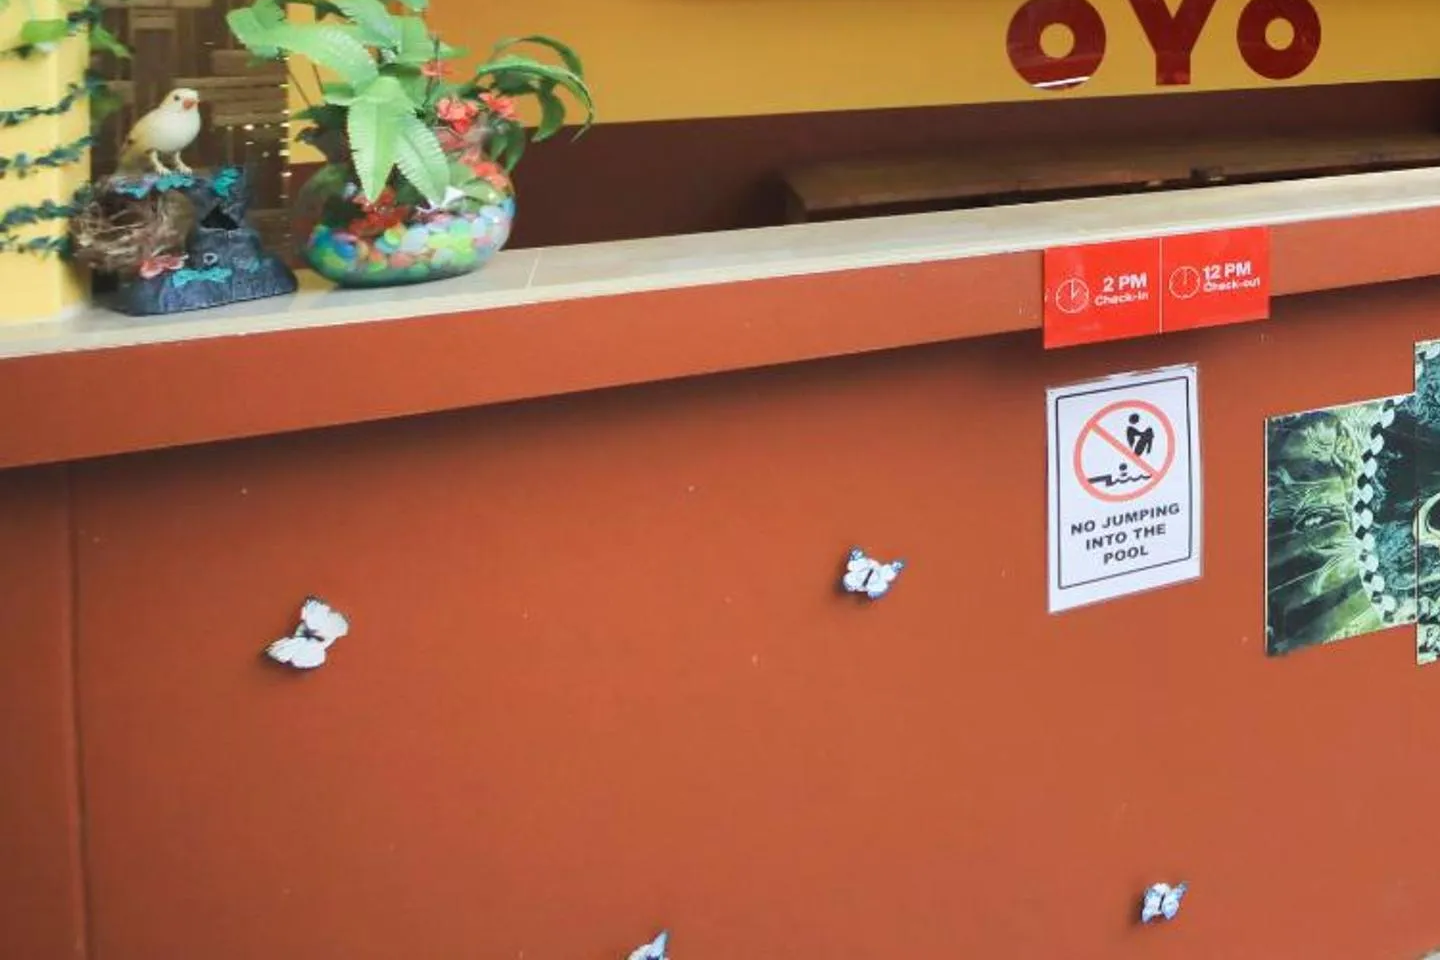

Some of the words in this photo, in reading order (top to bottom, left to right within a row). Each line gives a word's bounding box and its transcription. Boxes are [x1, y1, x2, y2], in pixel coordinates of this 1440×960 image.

[1203, 264, 1220, 280] 12
[1225, 261, 1251, 277] PM
[1103, 276, 1114, 292] 2
[1119, 272, 1147, 289] PM
[1203, 276, 1260, 293] Check-out
[1094, 290, 1149, 307] Check-in
[1071, 519, 1096, 536] NO
[1102, 502, 1180, 529] JUMPING
[1085, 532, 1127, 551] INTO
[1133, 523, 1166, 541] THE
[1103, 544, 1149, 565] POOL
